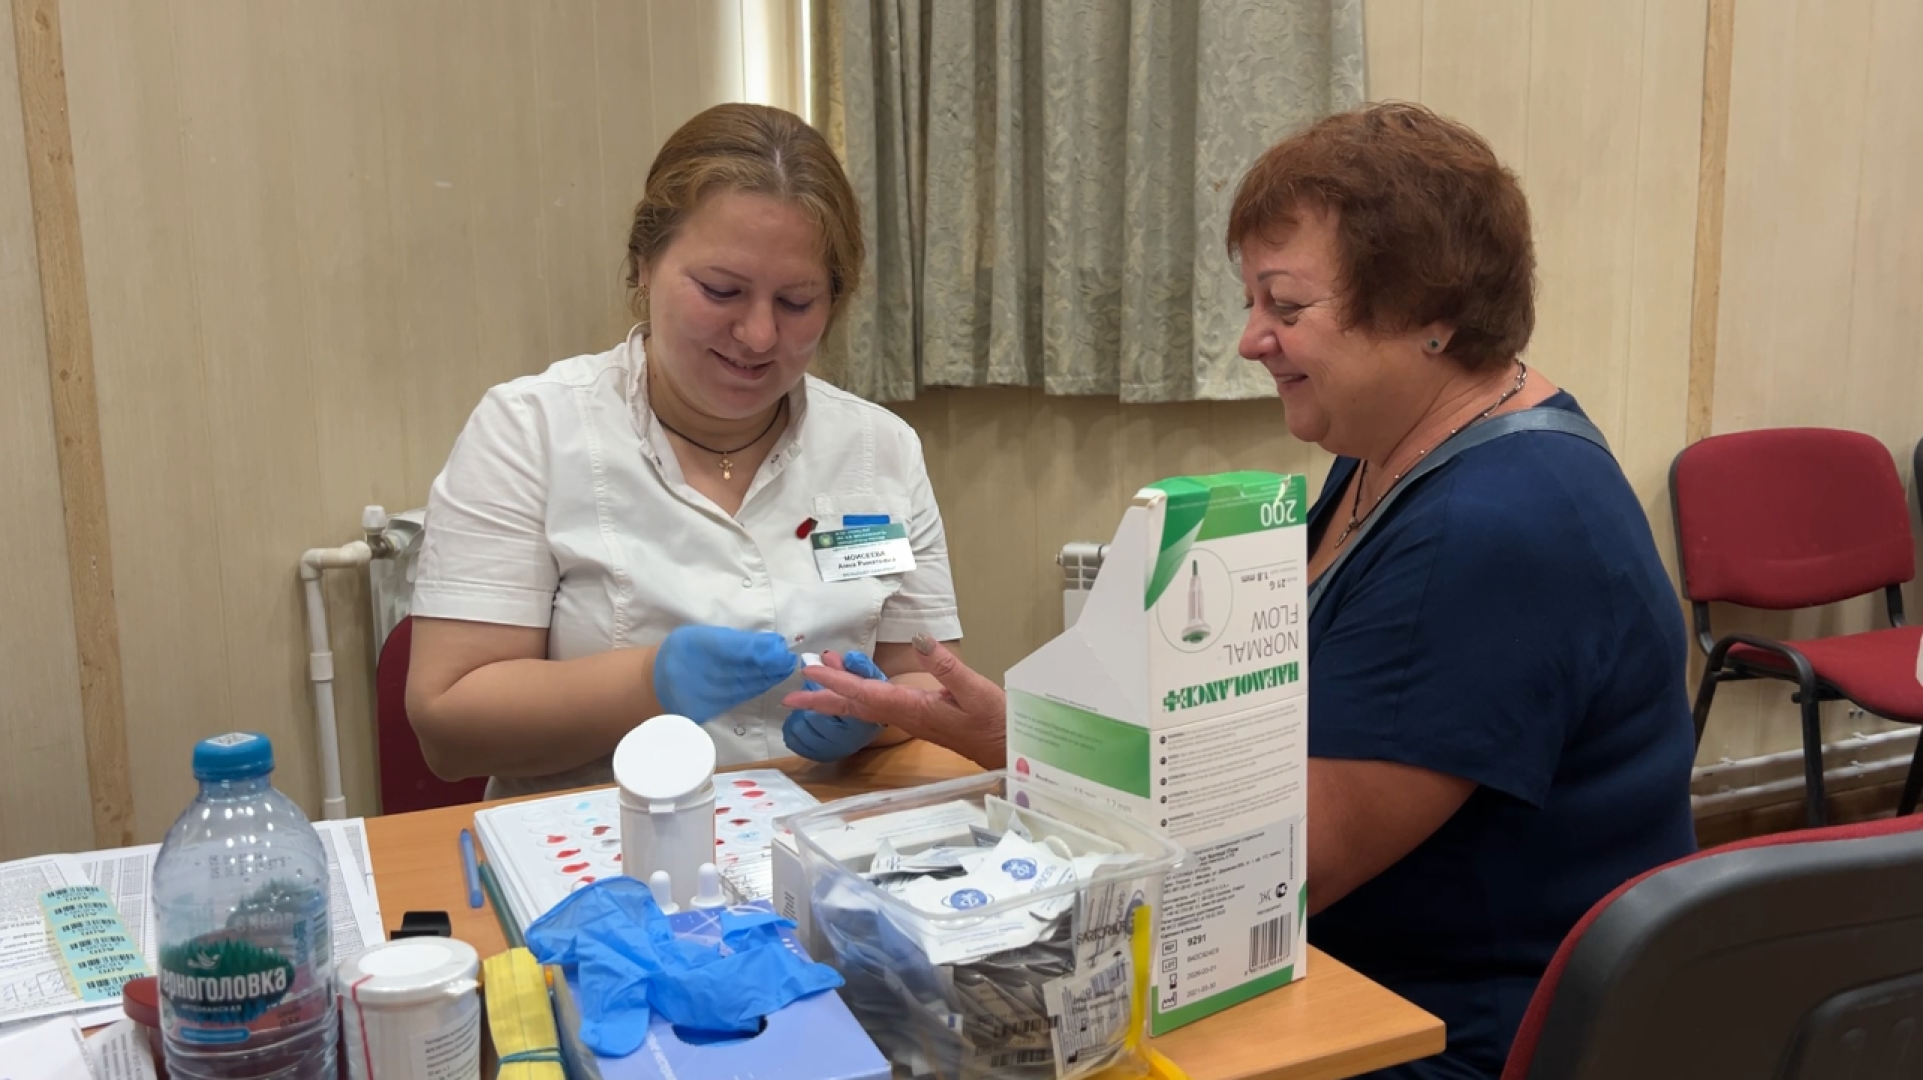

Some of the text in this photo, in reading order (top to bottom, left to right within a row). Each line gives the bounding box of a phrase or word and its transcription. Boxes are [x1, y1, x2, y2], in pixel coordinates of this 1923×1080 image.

[1261, 499, 1298, 527] 200
[844, 551, 886, 561] МОИСЕЕВА
[1250, 602, 1299, 633] FLOW
[1222, 630, 1300, 666] NORMAL
[1186, 932, 1207, 948] 9291
[161, 967, 287, 1001] ерноголовка
